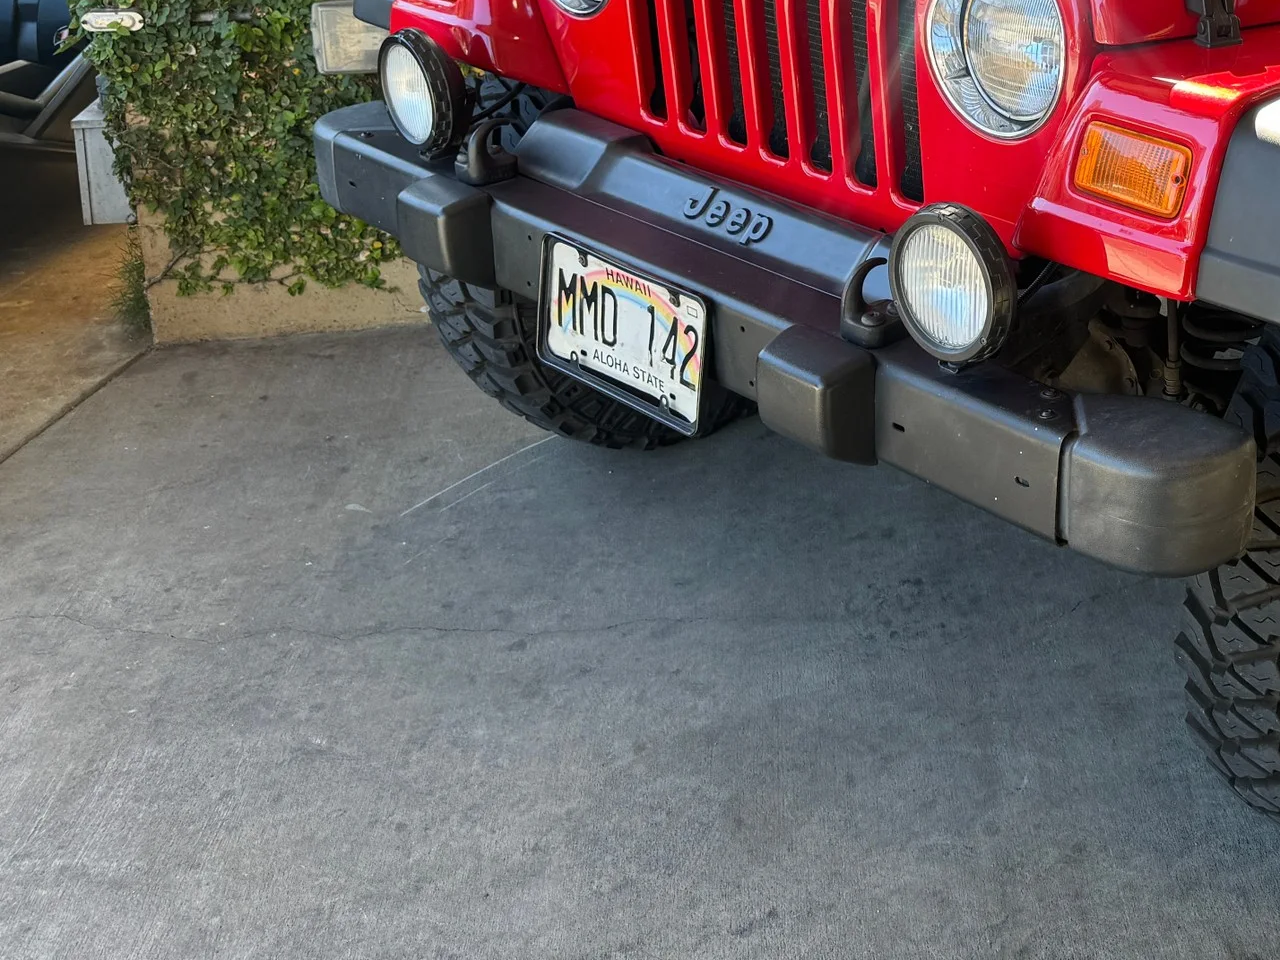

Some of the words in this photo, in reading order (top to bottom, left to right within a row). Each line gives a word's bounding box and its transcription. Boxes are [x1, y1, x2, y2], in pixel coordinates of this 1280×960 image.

[683, 186, 774, 246] Jeep
[605, 266, 652, 298] HAWAII
[557, 267, 618, 347] MMD
[647, 304, 700, 392] 142
[592, 348, 630, 376] ALOHA
[632, 366, 666, 393] STATE
